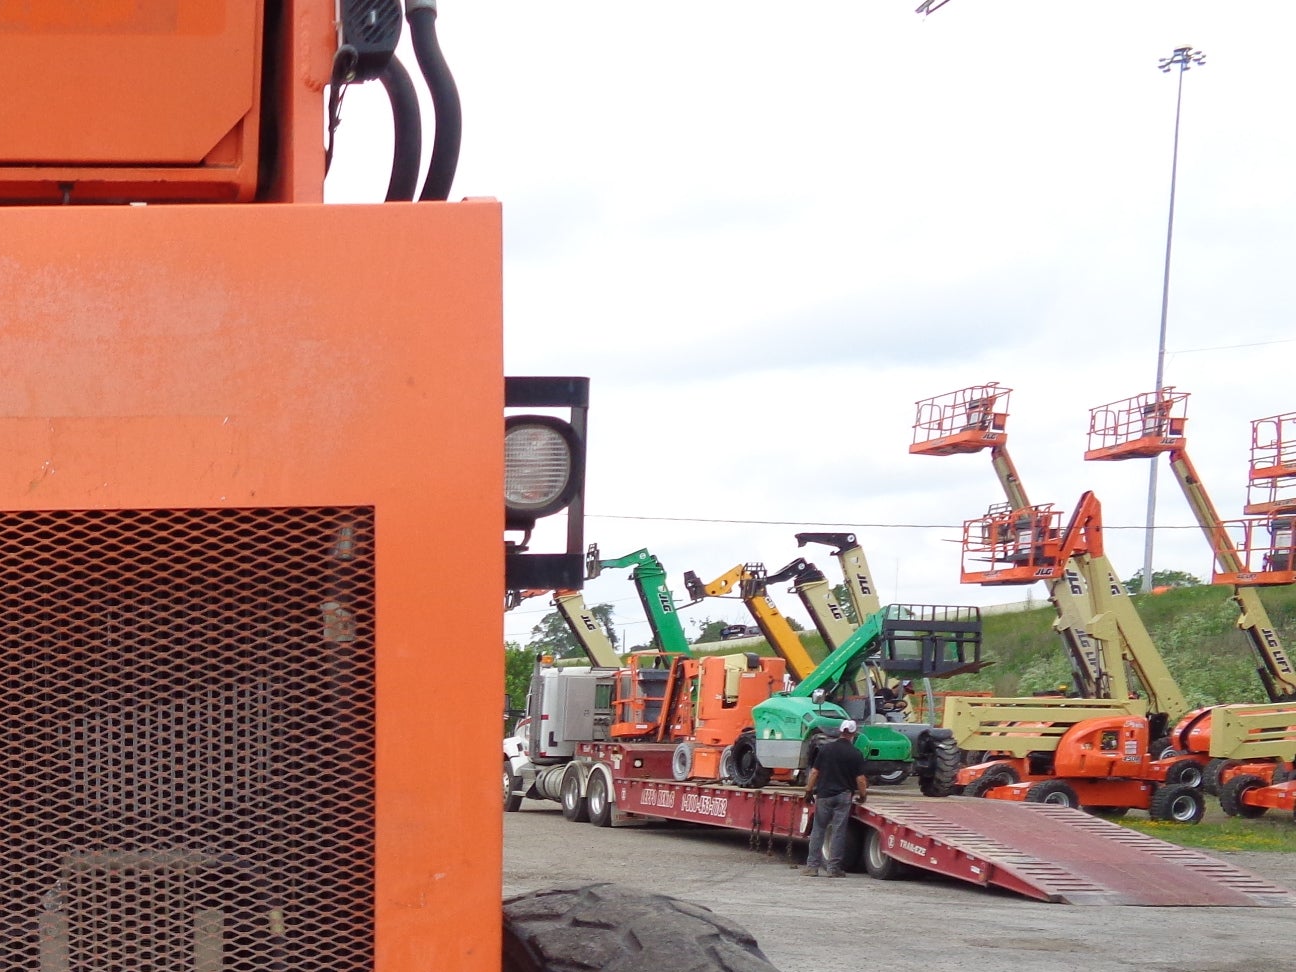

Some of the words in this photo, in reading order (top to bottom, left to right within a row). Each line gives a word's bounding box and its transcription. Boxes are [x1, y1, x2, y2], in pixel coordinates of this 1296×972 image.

[1035, 568, 1053, 576] JLG
[1066, 568, 1082, 594] JLG
[857, 573, 871, 595] JLG
[658, 593, 673, 613] JLG
[827, 603, 842, 620] JLG
[581, 614, 596, 631] JLG
[1262, 628, 1278, 648] JLG
[1272, 650, 1292, 673] LIFT
